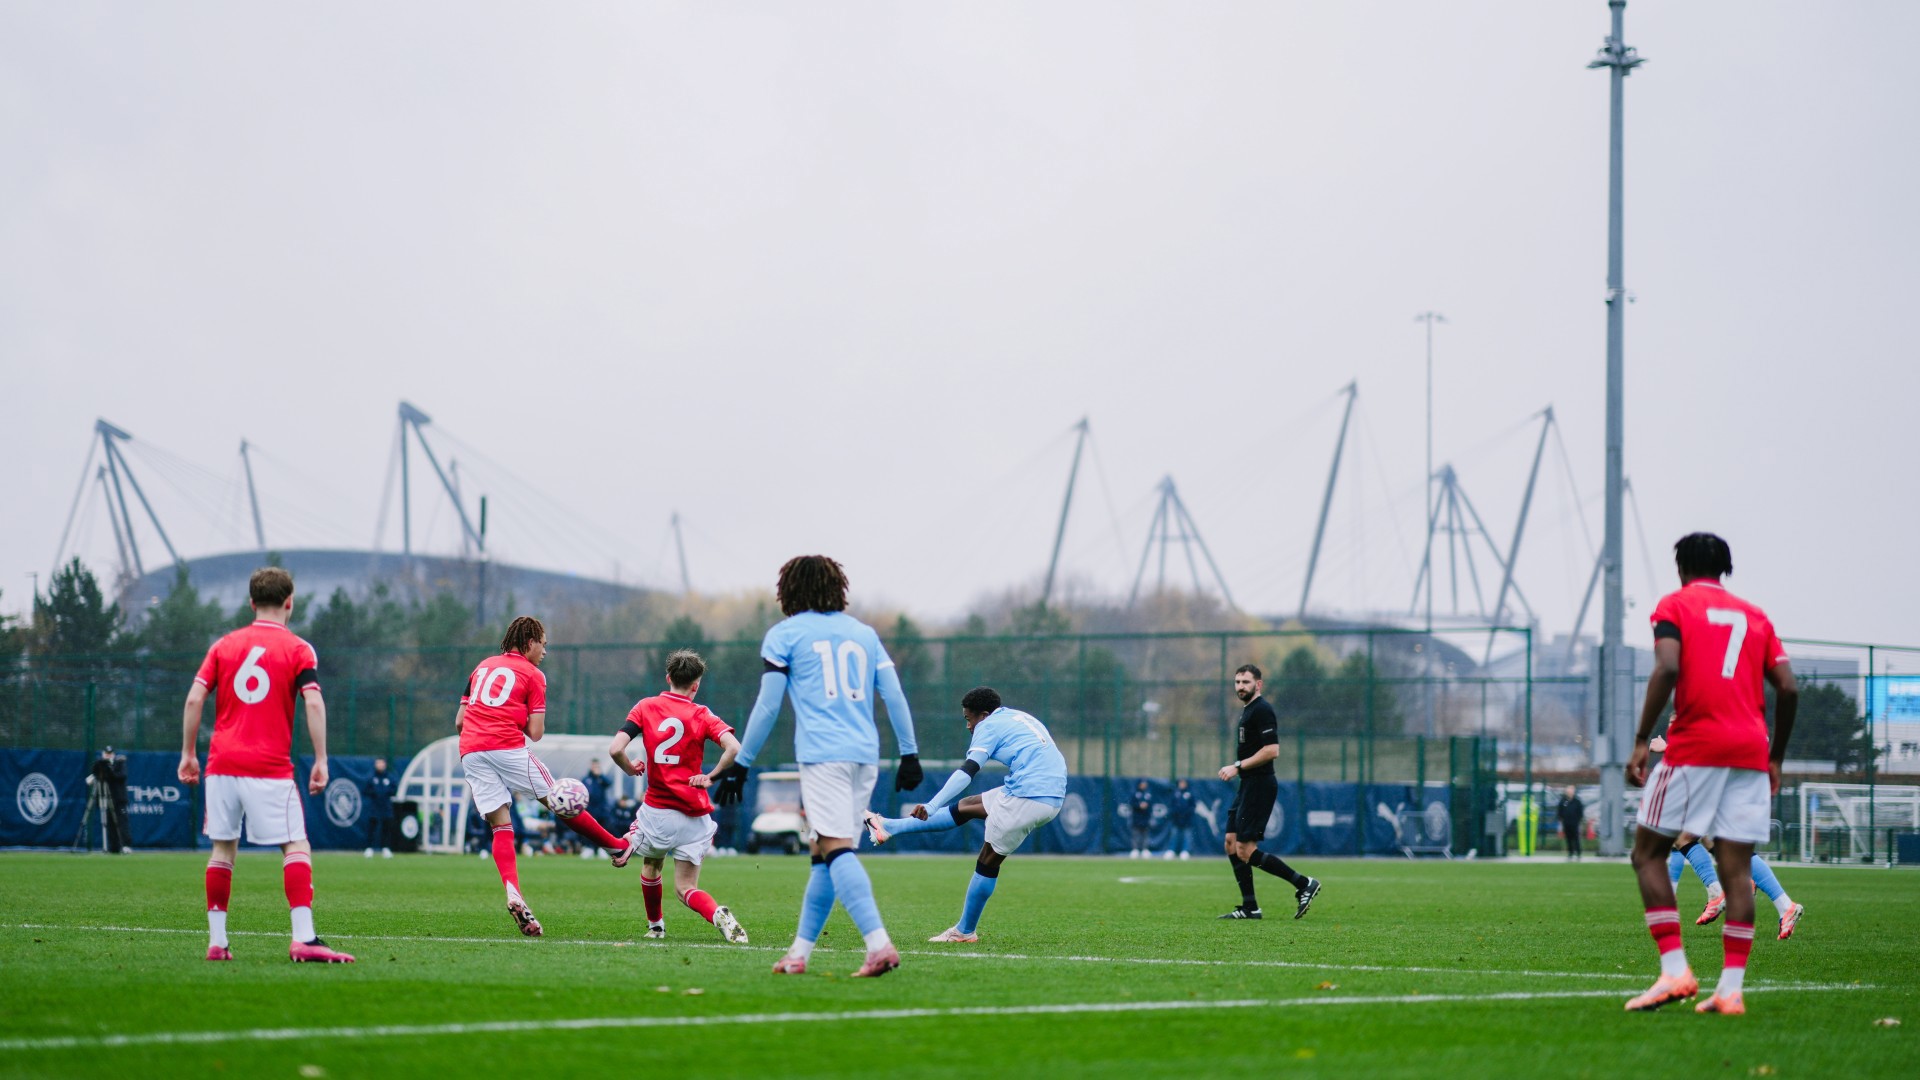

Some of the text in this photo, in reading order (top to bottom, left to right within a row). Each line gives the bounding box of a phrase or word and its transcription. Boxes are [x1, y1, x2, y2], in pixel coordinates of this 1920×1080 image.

[812, 640, 867, 702] 10
[1706, 607, 1748, 679] 7
[233, 645, 270, 704] 6
[469, 667, 516, 707] 10
[654, 717, 684, 765] 2
